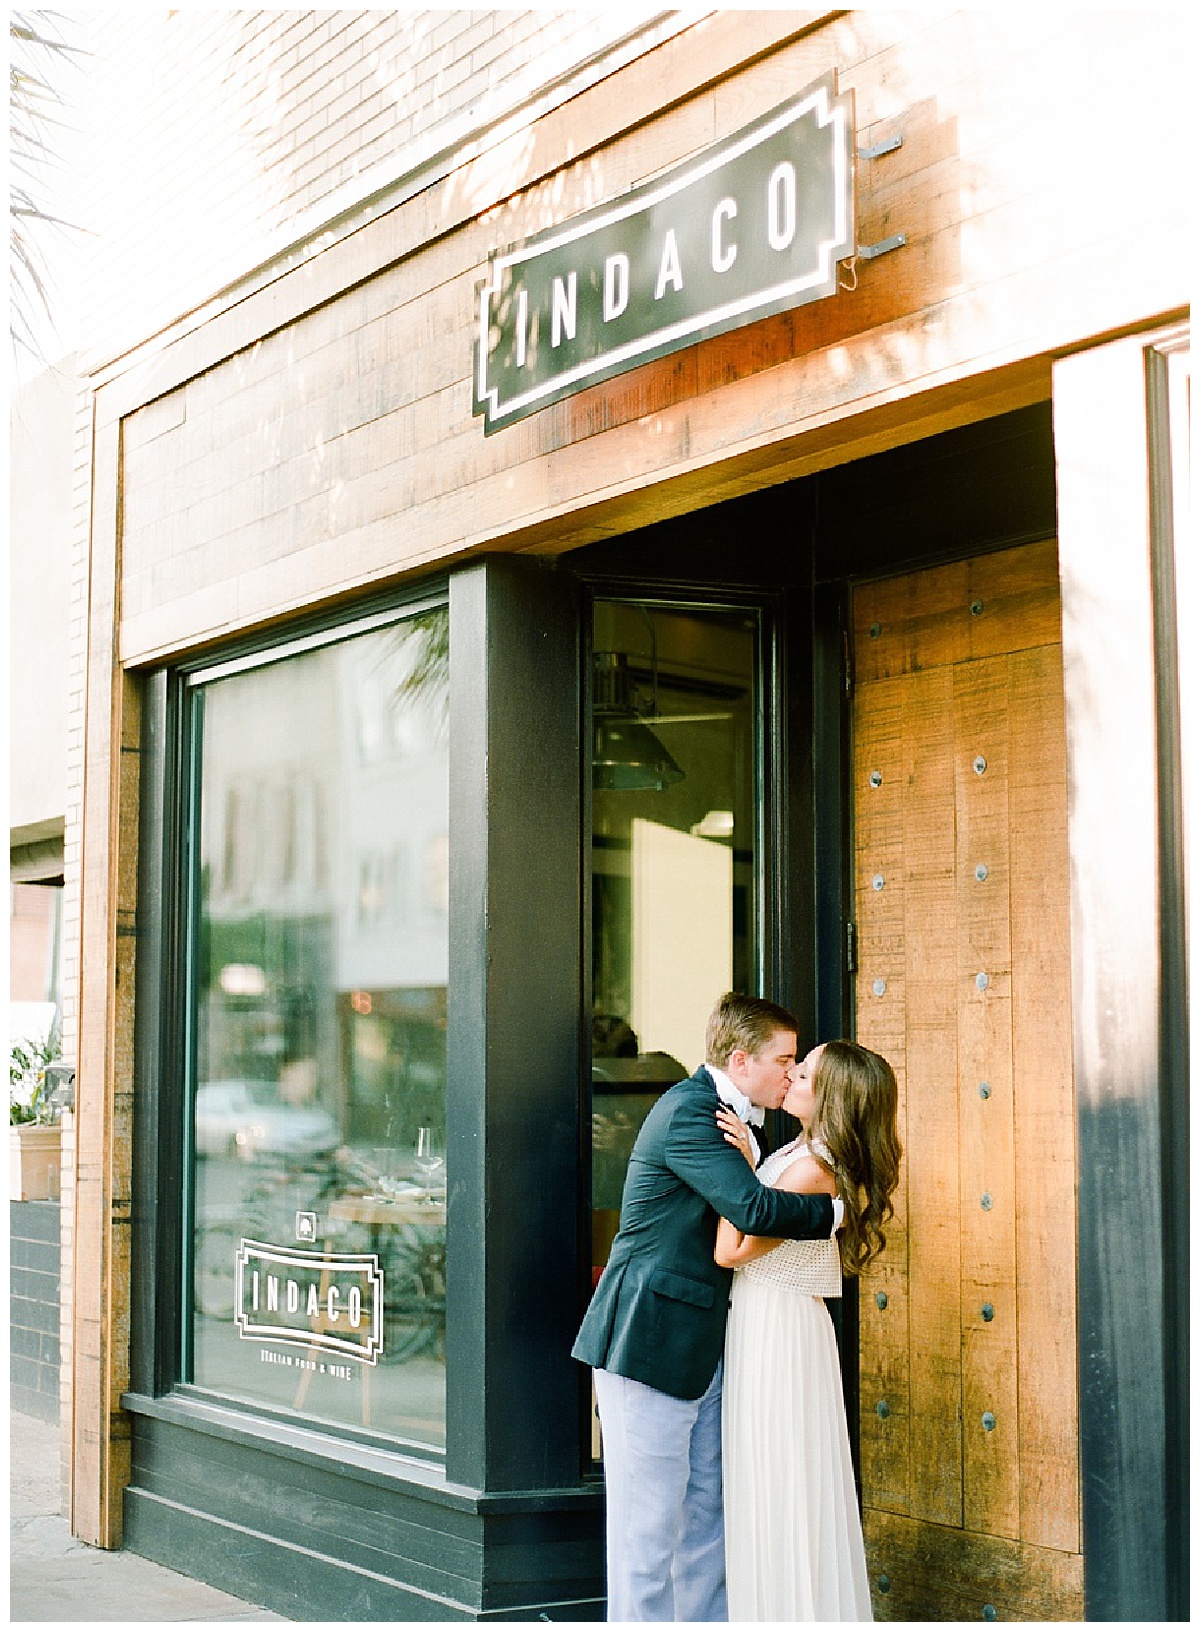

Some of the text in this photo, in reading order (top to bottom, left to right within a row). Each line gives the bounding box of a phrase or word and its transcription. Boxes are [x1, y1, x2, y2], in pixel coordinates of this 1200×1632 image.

[516, 161, 796, 367] INDACO
[253, 1271, 360, 1328] INDACO
[261, 1349, 292, 1366] ITALIAN
[329, 1365, 351, 1381] WINE
